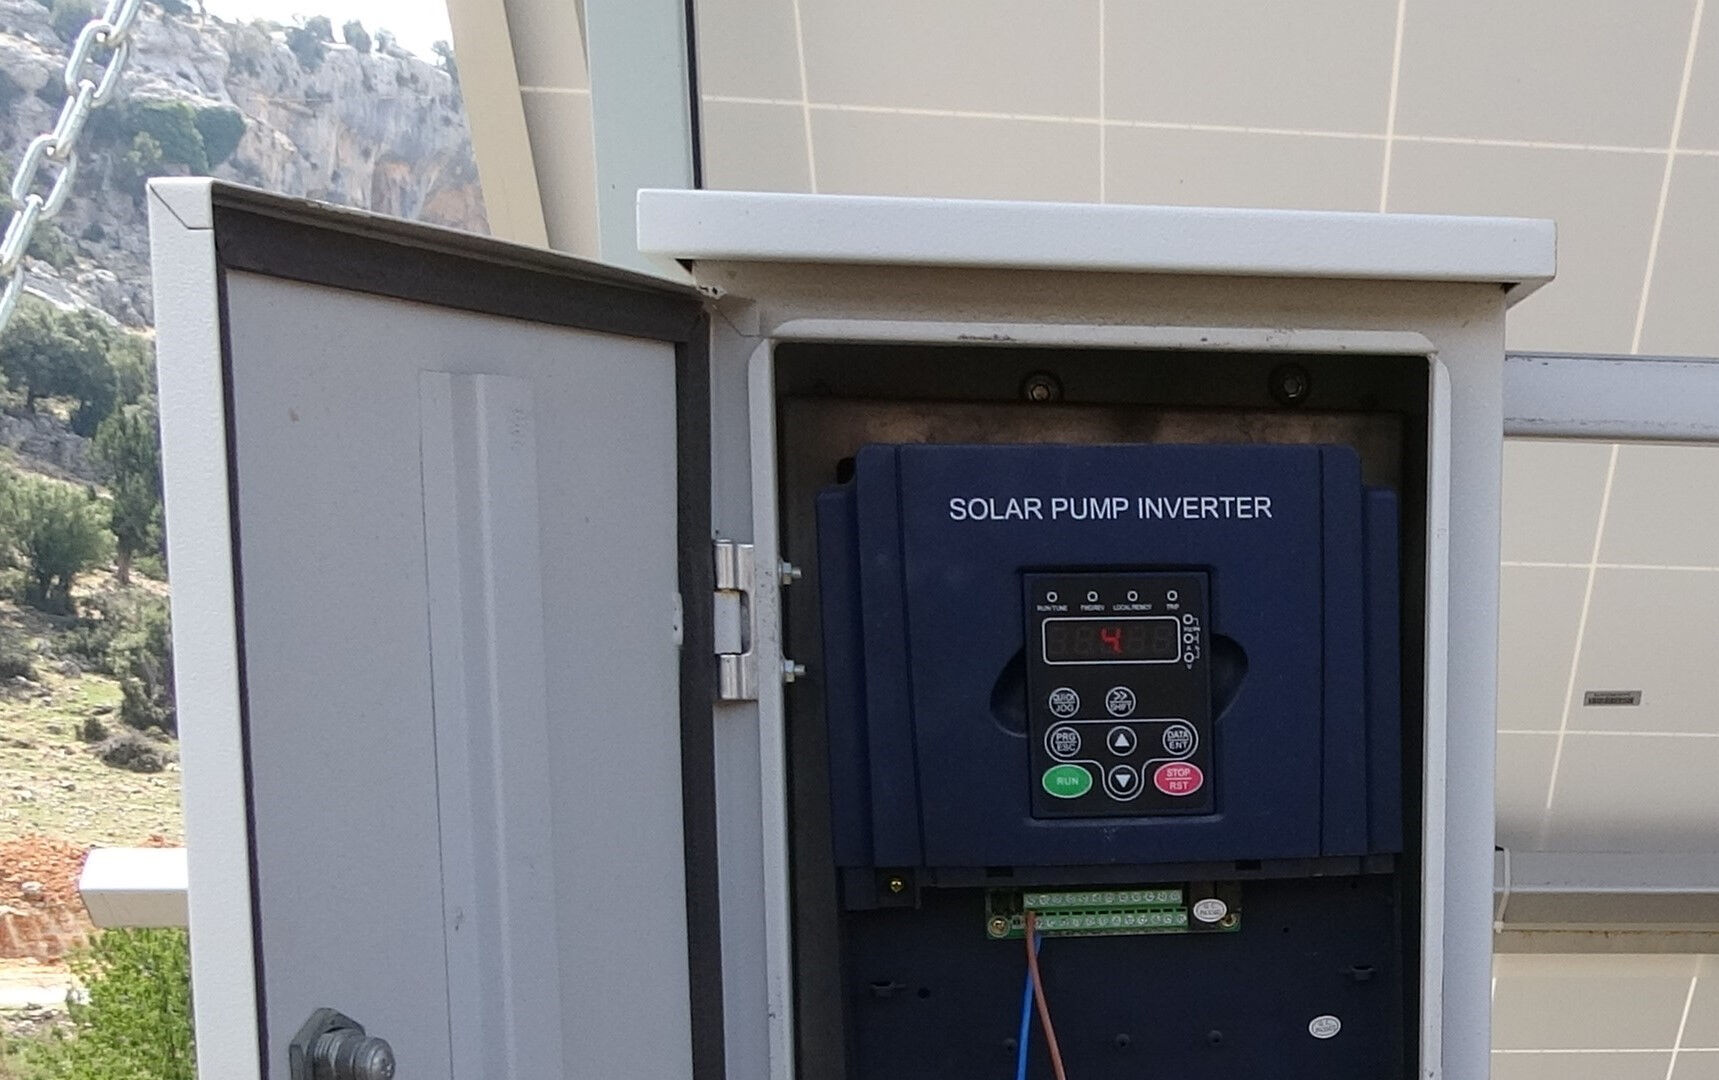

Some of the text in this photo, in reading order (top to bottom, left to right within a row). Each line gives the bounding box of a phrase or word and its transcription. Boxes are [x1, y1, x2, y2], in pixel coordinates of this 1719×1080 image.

[949, 496, 1273, 521] SOLAR PUMP INVERTER
[1101, 628, 1121, 652] 4
[1055, 704, 1074, 713] JOG
[1110, 703, 1132, 712] SHIFT
[1056, 732, 1076, 742] PRG
[1166, 730, 1188, 740] DATA
[1057, 742, 1076, 752] ESC
[1169, 740, 1188, 750] ENT
[1166, 768, 1191, 778] STOP
[1056, 777, 1079, 786] RUN
[1169, 781, 1189, 790] RST
